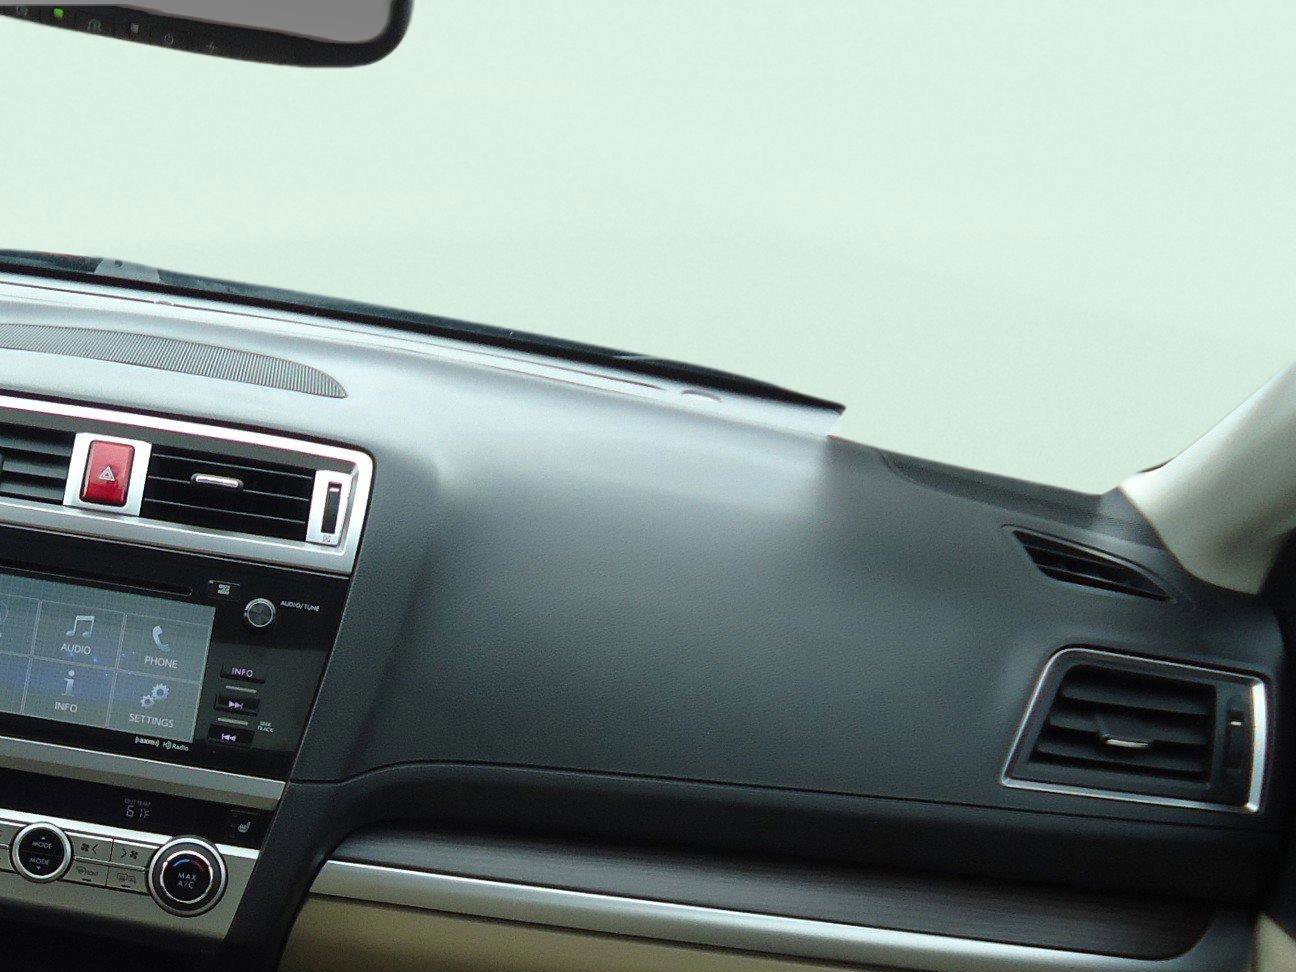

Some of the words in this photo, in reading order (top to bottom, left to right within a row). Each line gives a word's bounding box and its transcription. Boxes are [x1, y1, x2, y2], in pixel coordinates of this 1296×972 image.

[60, 643, 92, 655] AUDIO
[144, 656, 179, 669] PHONE
[231, 667, 253, 678] INFO
[54, 701, 78, 713] INFO
[129, 713, 175, 728] SETTINGS
[31, 840, 53, 850] MODE
[29, 857, 50, 866] MODE
[177, 872, 197, 881] MAX
[176, 880, 195, 889] A/C
